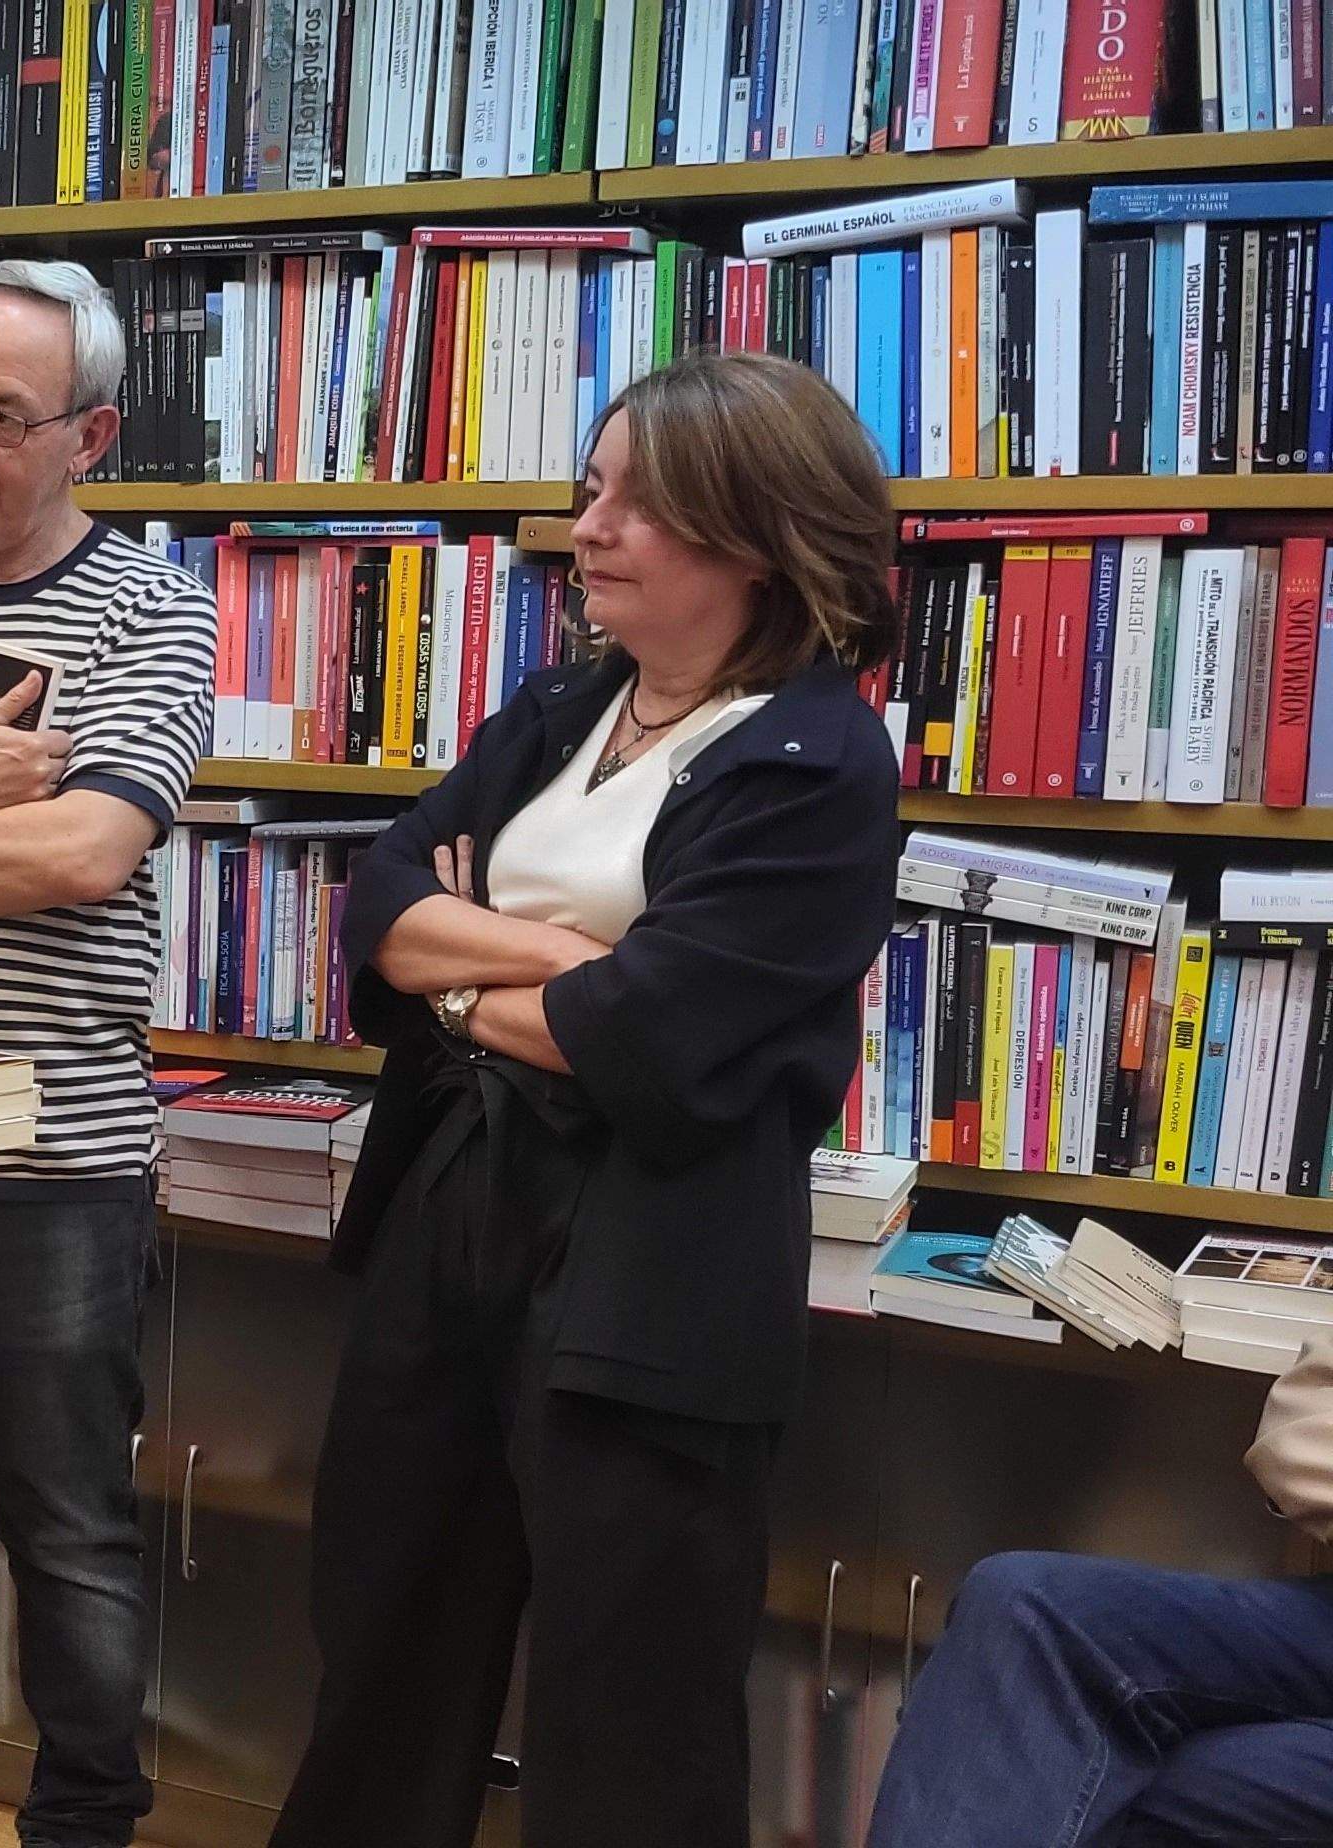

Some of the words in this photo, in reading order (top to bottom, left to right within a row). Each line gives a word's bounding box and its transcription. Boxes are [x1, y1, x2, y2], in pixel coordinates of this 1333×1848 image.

[483, 40, 499, 81] IBÉRICA
[958, 36, 975, 74] España
[130, 54, 145, 98] CIVIL
[293, 7, 323, 137] Borregueros
[957, 76, 969, 89] La
[1083, 73, 1134, 85] HISTORIA
[1081, 90, 1132, 101] FAMILIAS
[87, 90, 103, 136] MAQUIS!
[86, 137, 102, 152] EL
[129, 104, 143, 171] GUERRA
[85, 153, 102, 184] ¡VIVA
[903, 196, 963, 214] FRANCISCO
[903, 206, 947, 223] SÁNCHEZ
[948, 202, 981, 218] PÉREZ
[764, 230, 778, 245] EL
[780, 223, 840, 241] GERMINAL
[843, 210, 896, 231] ESPAÑOL
[1185, 262, 1202, 340] RESISTENCIA
[1182, 341, 1199, 399] CHOMSKY
[318, 370, 329, 416] ALMANAQUE
[330, 384, 341, 411] COSTA
[327, 411, 339, 449] JOAQUÍN
[1181, 402, 1197, 437] NOAM
[333, 524, 359, 534] crónica
[360, 524, 370, 534] de
[371, 525, 385, 534] una
[386, 523, 414, 534] victoria
[400, 555, 409, 584] MICHAEL
[471, 555, 488, 626] ULLRICH
[1096, 554, 1115, 628] IGNATIEFF
[1127, 555, 1149, 635] JEFFRIES
[1198, 569, 1209, 602] Violencia
[1208, 577, 1224, 601] MITO
[399, 590, 408, 617] SANDEL
[521, 592, 530, 611] ARTE
[1208, 602, 1217, 610] DE
[442, 588, 456, 643] Mutaciones
[520, 611, 529, 619] EL
[1196, 610, 1206, 637] política
[397, 634, 406, 643] EL
[417, 631, 431, 663] COSAS
[517, 625, 528, 658] MONTAÑA
[1202, 619, 1220, 676] TRANSICIÓN
[395, 644, 406, 692] DESCONTENTO
[440, 645, 452, 671] Roger
[471, 652, 482, 675] mayo
[517, 657, 526, 667] LA
[1192, 650, 1202, 676] España
[1278, 598, 1316, 728] NORMANDOS
[416, 672, 429, 690] MÁS
[439, 673, 451, 703] Bartra
[468, 675, 478, 686] de
[1091, 661, 1103, 695] consuelo
[1120, 664, 1133, 689] horas,
[1132, 665, 1143, 690] partes
[414, 691, 428, 720] COSAS
[466, 687, 477, 704] días
[1090, 696, 1100, 707] de
[1118, 690, 1130, 711] todas
[1130, 690, 1140, 712] todas
[1199, 678, 1217, 719] PACÍFICA
[393, 693, 404, 741] DEMOCRÁTICO
[466, 704, 476, 728] Ocho
[1087, 707, 1099, 729] busca
[1115, 721, 1126, 740] Todo,
[1186, 725, 1202, 765] BABY
[1200, 725, 1214, 765] SOPHIE
[311, 852, 321, 877] Rafael
[979, 857, 1038, 876] MIGRAÑA
[310, 879, 320, 923] Santandreu
[1105, 901, 1126, 916] KING
[1127, 904, 1153, 922] CORP.
[218, 930, 230, 955] SOFÍA
[948, 925, 956, 934] LA
[1100, 921, 1121, 936] KING
[1123, 925, 1148, 942] CORP.
[1260, 927, 1288, 936] Donna
[1267, 936, 1303, 946] Haraway
[947, 934, 955, 958] PUERTA
[217, 972, 229, 997] ÉTICA
[946, 959, 955, 990] CERRADA
[1038, 985, 1049, 1023] optimista
[1112, 991, 1124, 1013] RITA
[1177, 992, 1203, 1019] Latin
[866, 1030, 874, 1038] DE
[993, 1010, 1003, 1034] España
[1074, 1012, 1085, 1032] juego
[1110, 1015, 1121, 1039] LEVI
[873, 1038, 882, 1053] GRAN
[1037, 1023, 1046, 1052] cerebro
[1174, 1021, 1195, 1050] QUEEN
[865, 1038, 874, 1063] PILATES
[873, 1054, 882, 1073] LIBRO
[1012, 1030, 1027, 1090] DEPRESIÓN
[1037, 1052, 1045, 1061] El
[1072, 1038, 1083, 1066] infancia
[992, 1057, 1001, 1073] José
[1102, 1041, 1119, 1105] MONTALCINI
[1070, 1066, 1082, 1097] Cerebro,
[1172, 1062, 1186, 1099] MARIAH
[203, 1094, 341, 1109] Corriente
[229, 1089, 343, 1103] Contra
[1169, 1101, 1183, 1133] OLIVER
